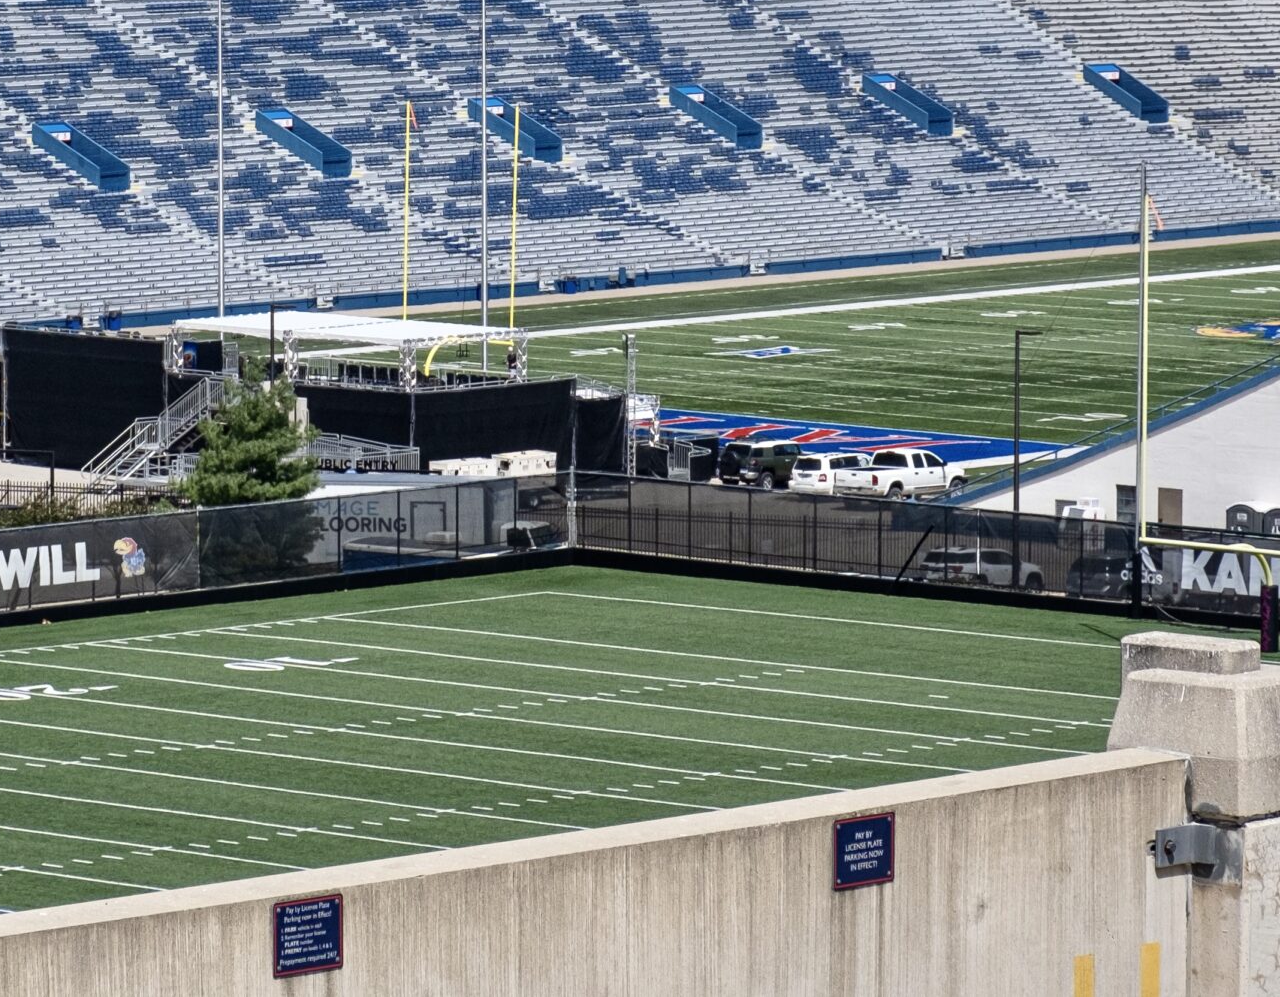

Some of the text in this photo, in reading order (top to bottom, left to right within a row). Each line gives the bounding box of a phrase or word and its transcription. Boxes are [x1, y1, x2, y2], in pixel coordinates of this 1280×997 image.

[316, 458, 398, 471] UBLIC ENTRY
[320, 516, 407, 533] LOORING
[855, 831, 873, 840] PAY BY
[845, 839, 883, 852] LICENSE PLATE
[844, 850, 884, 862] PARKING NOW
[850, 863, 857, 872] IN
